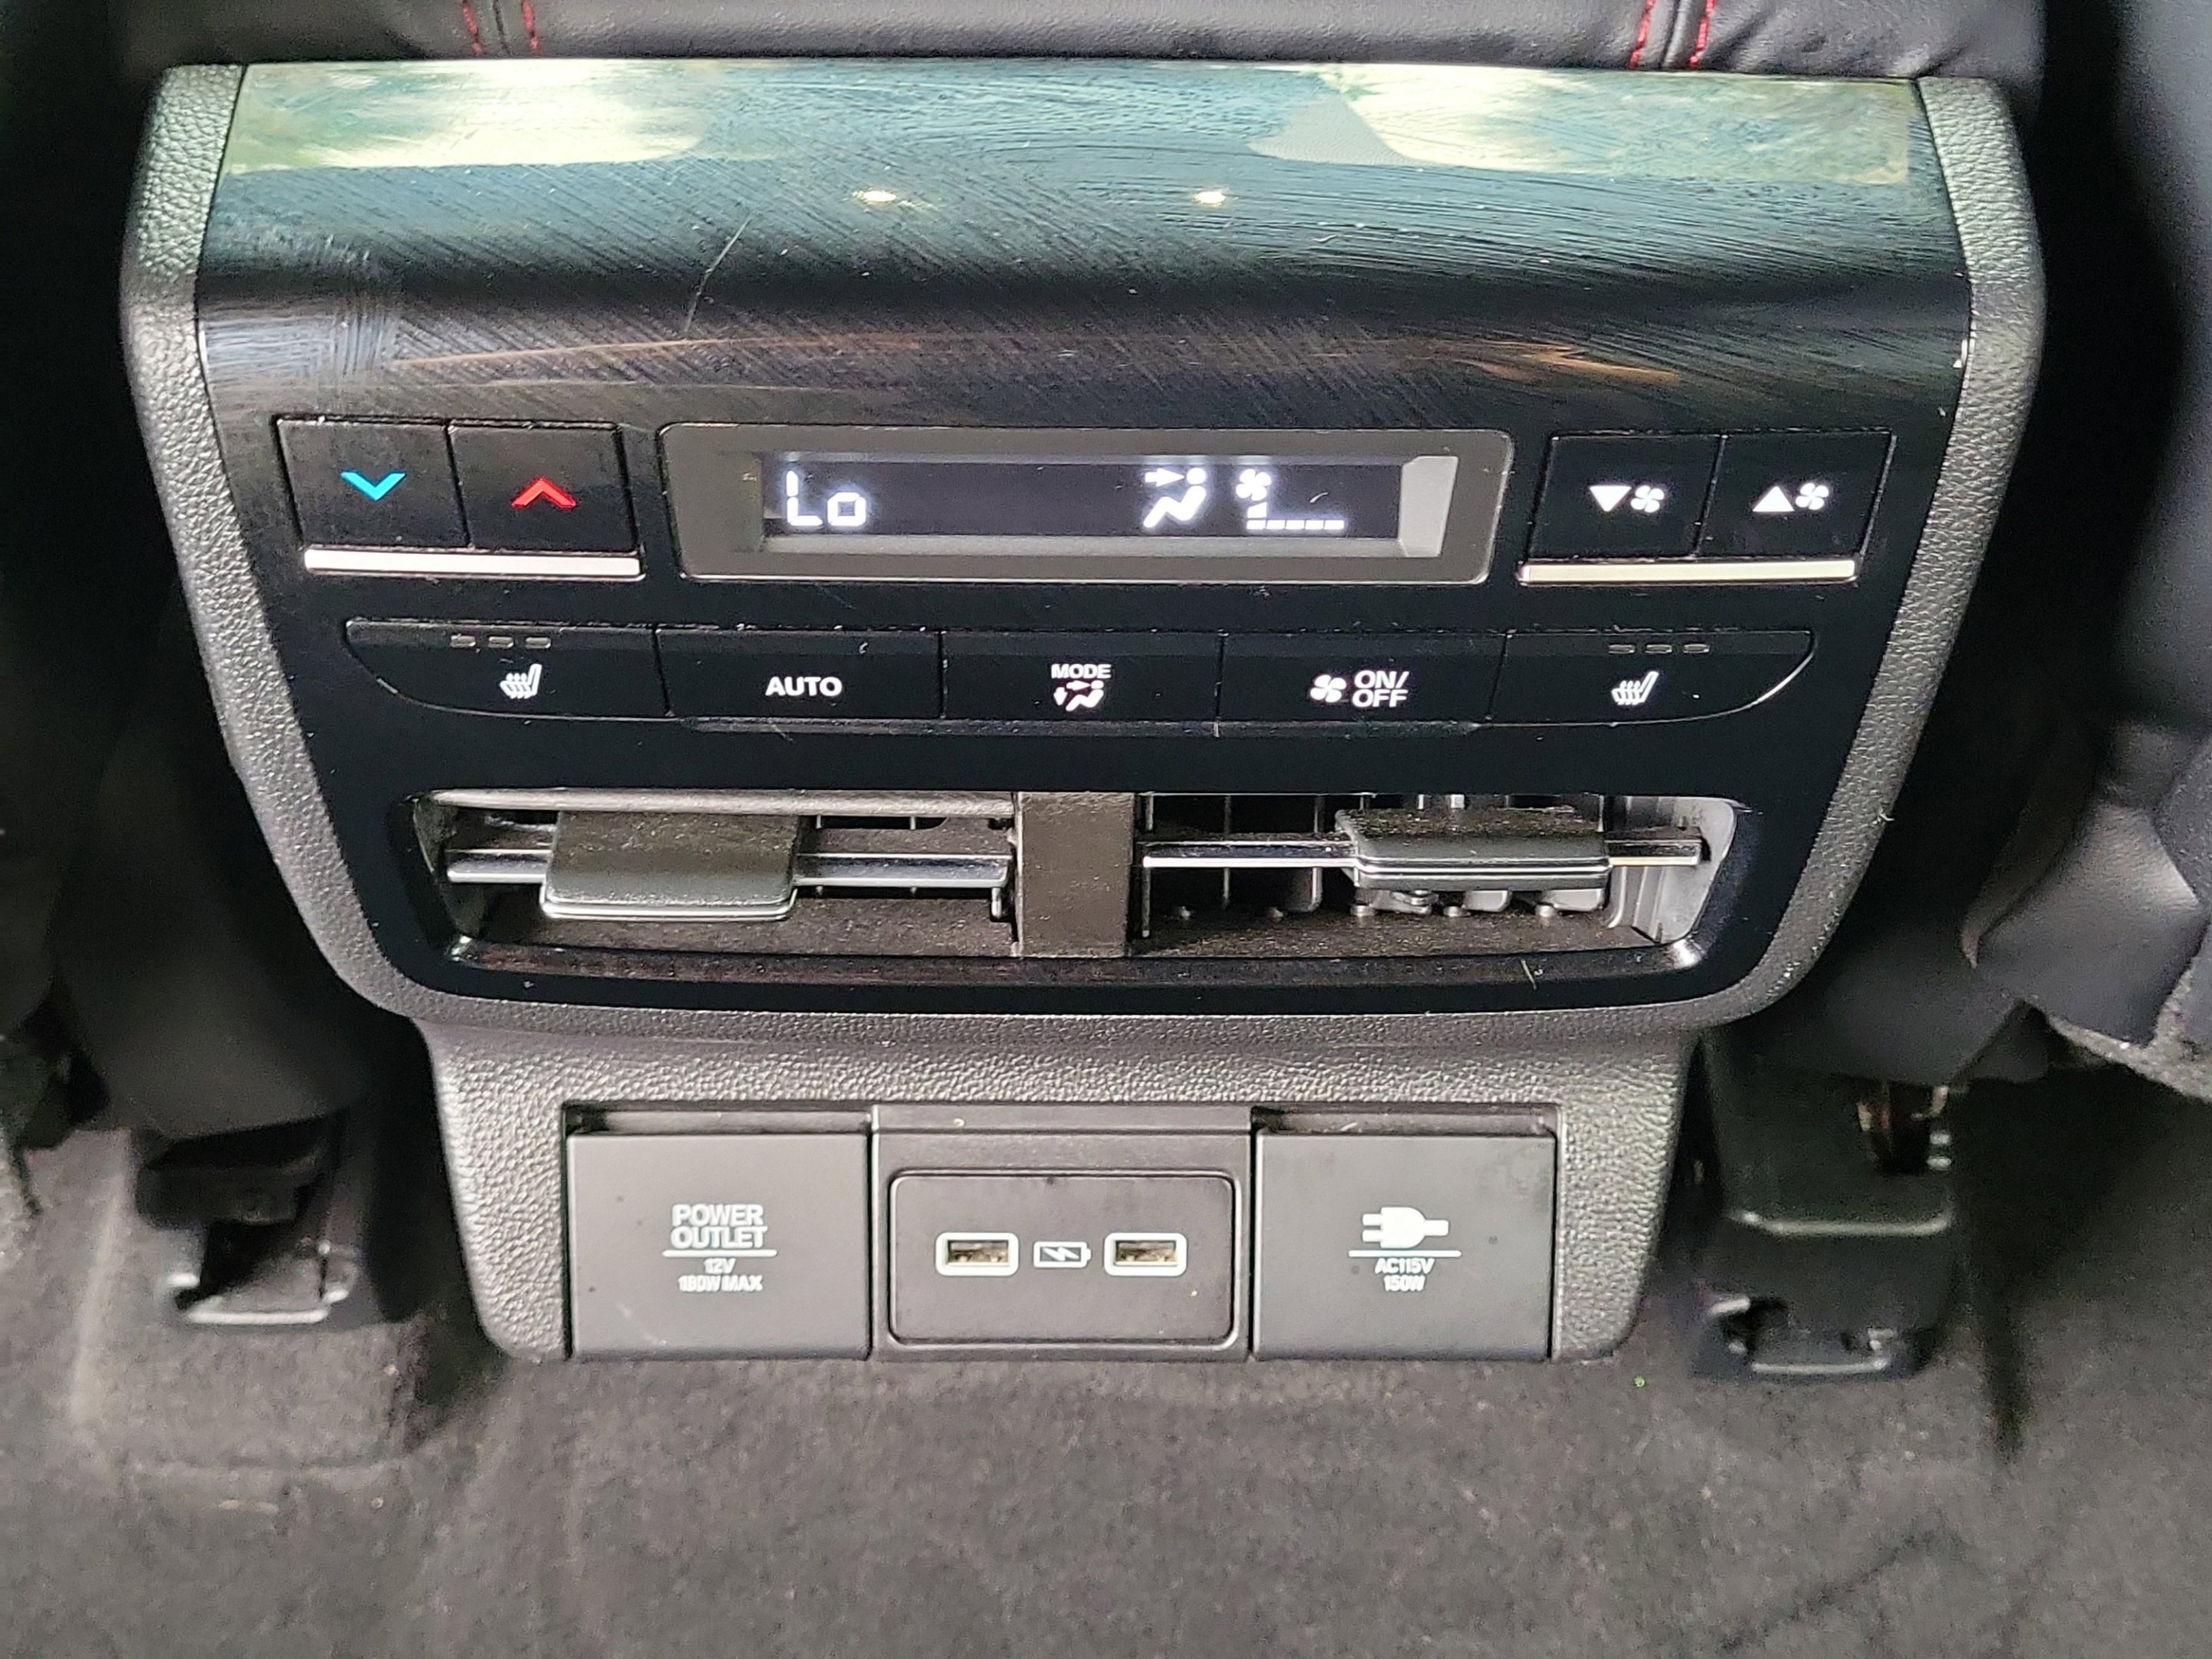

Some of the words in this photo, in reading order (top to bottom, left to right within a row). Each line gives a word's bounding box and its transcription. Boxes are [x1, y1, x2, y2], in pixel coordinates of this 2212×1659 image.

[784, 469, 868, 528] Lo
[1051, 663, 1112, 680] MODE
[1353, 670, 1410, 689] ON/
[765, 676, 843, 697] AUTO
[1352, 689, 1409, 708] OFF
[671, 1204, 764, 1227] POWER
[670, 1226, 768, 1249] OUTLET
[704, 1257, 736, 1274] 12V
[1374, 1257, 1435, 1274] AC115V
[677, 1275, 721, 1292] 180W
[721, 1275, 763, 1292] MAX
[1383, 1275, 1426, 1292] 150W
